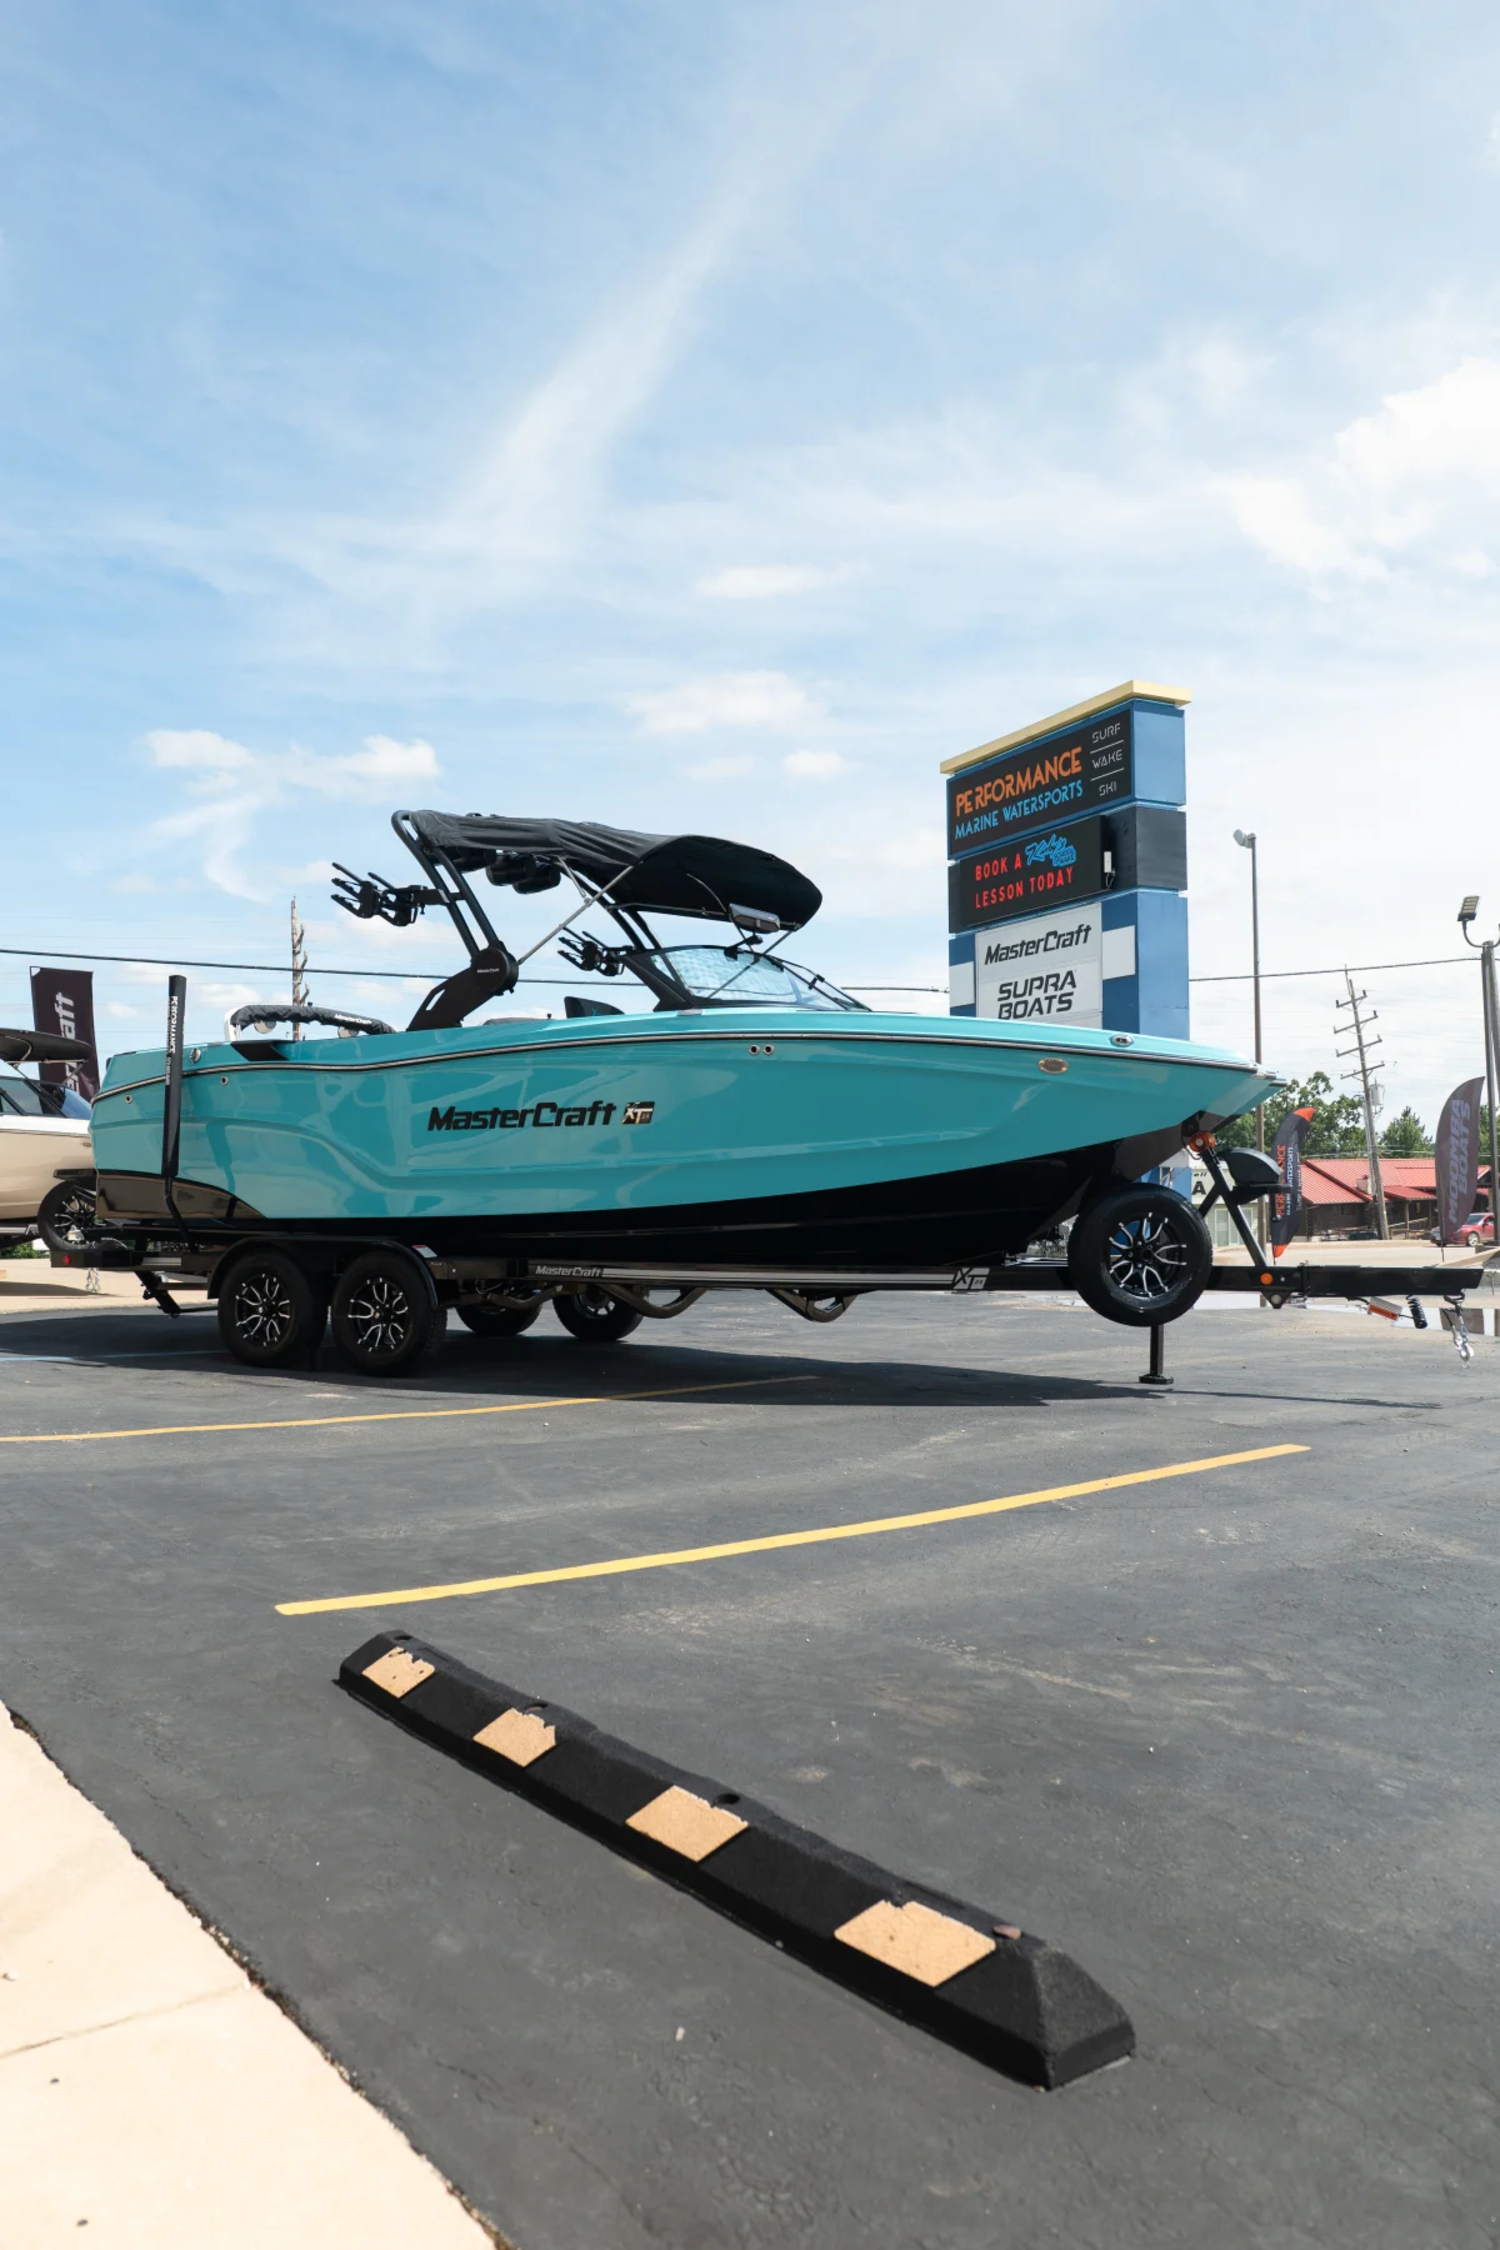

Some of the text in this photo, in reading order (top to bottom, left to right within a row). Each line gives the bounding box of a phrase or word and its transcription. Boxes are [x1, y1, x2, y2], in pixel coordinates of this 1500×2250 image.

[1091, 722, 1121, 744] SURF
[1092, 749, 1123, 769] WAKE
[956, 746, 1082, 817] PERFORMANCE
[1098, 780, 1117, 796] SKI
[954, 779, 1084, 840] MARINE WATERSPORTS
[974, 852, 1022, 881] BOOK A
[975, 866, 1074, 909] LESSON TODAY
[984, 923, 1092, 966] MasterCraft
[997, 969, 1077, 1002] SUPRA
[998, 991, 1074, 1020] BOATS
[427, 1100, 617, 1132] MasterCraft
[1448, 1099, 1461, 1224] MOOMBA
[1458, 1100, 1471, 1195] BOATS
[535, 1265, 602, 1277] MasterCraft
